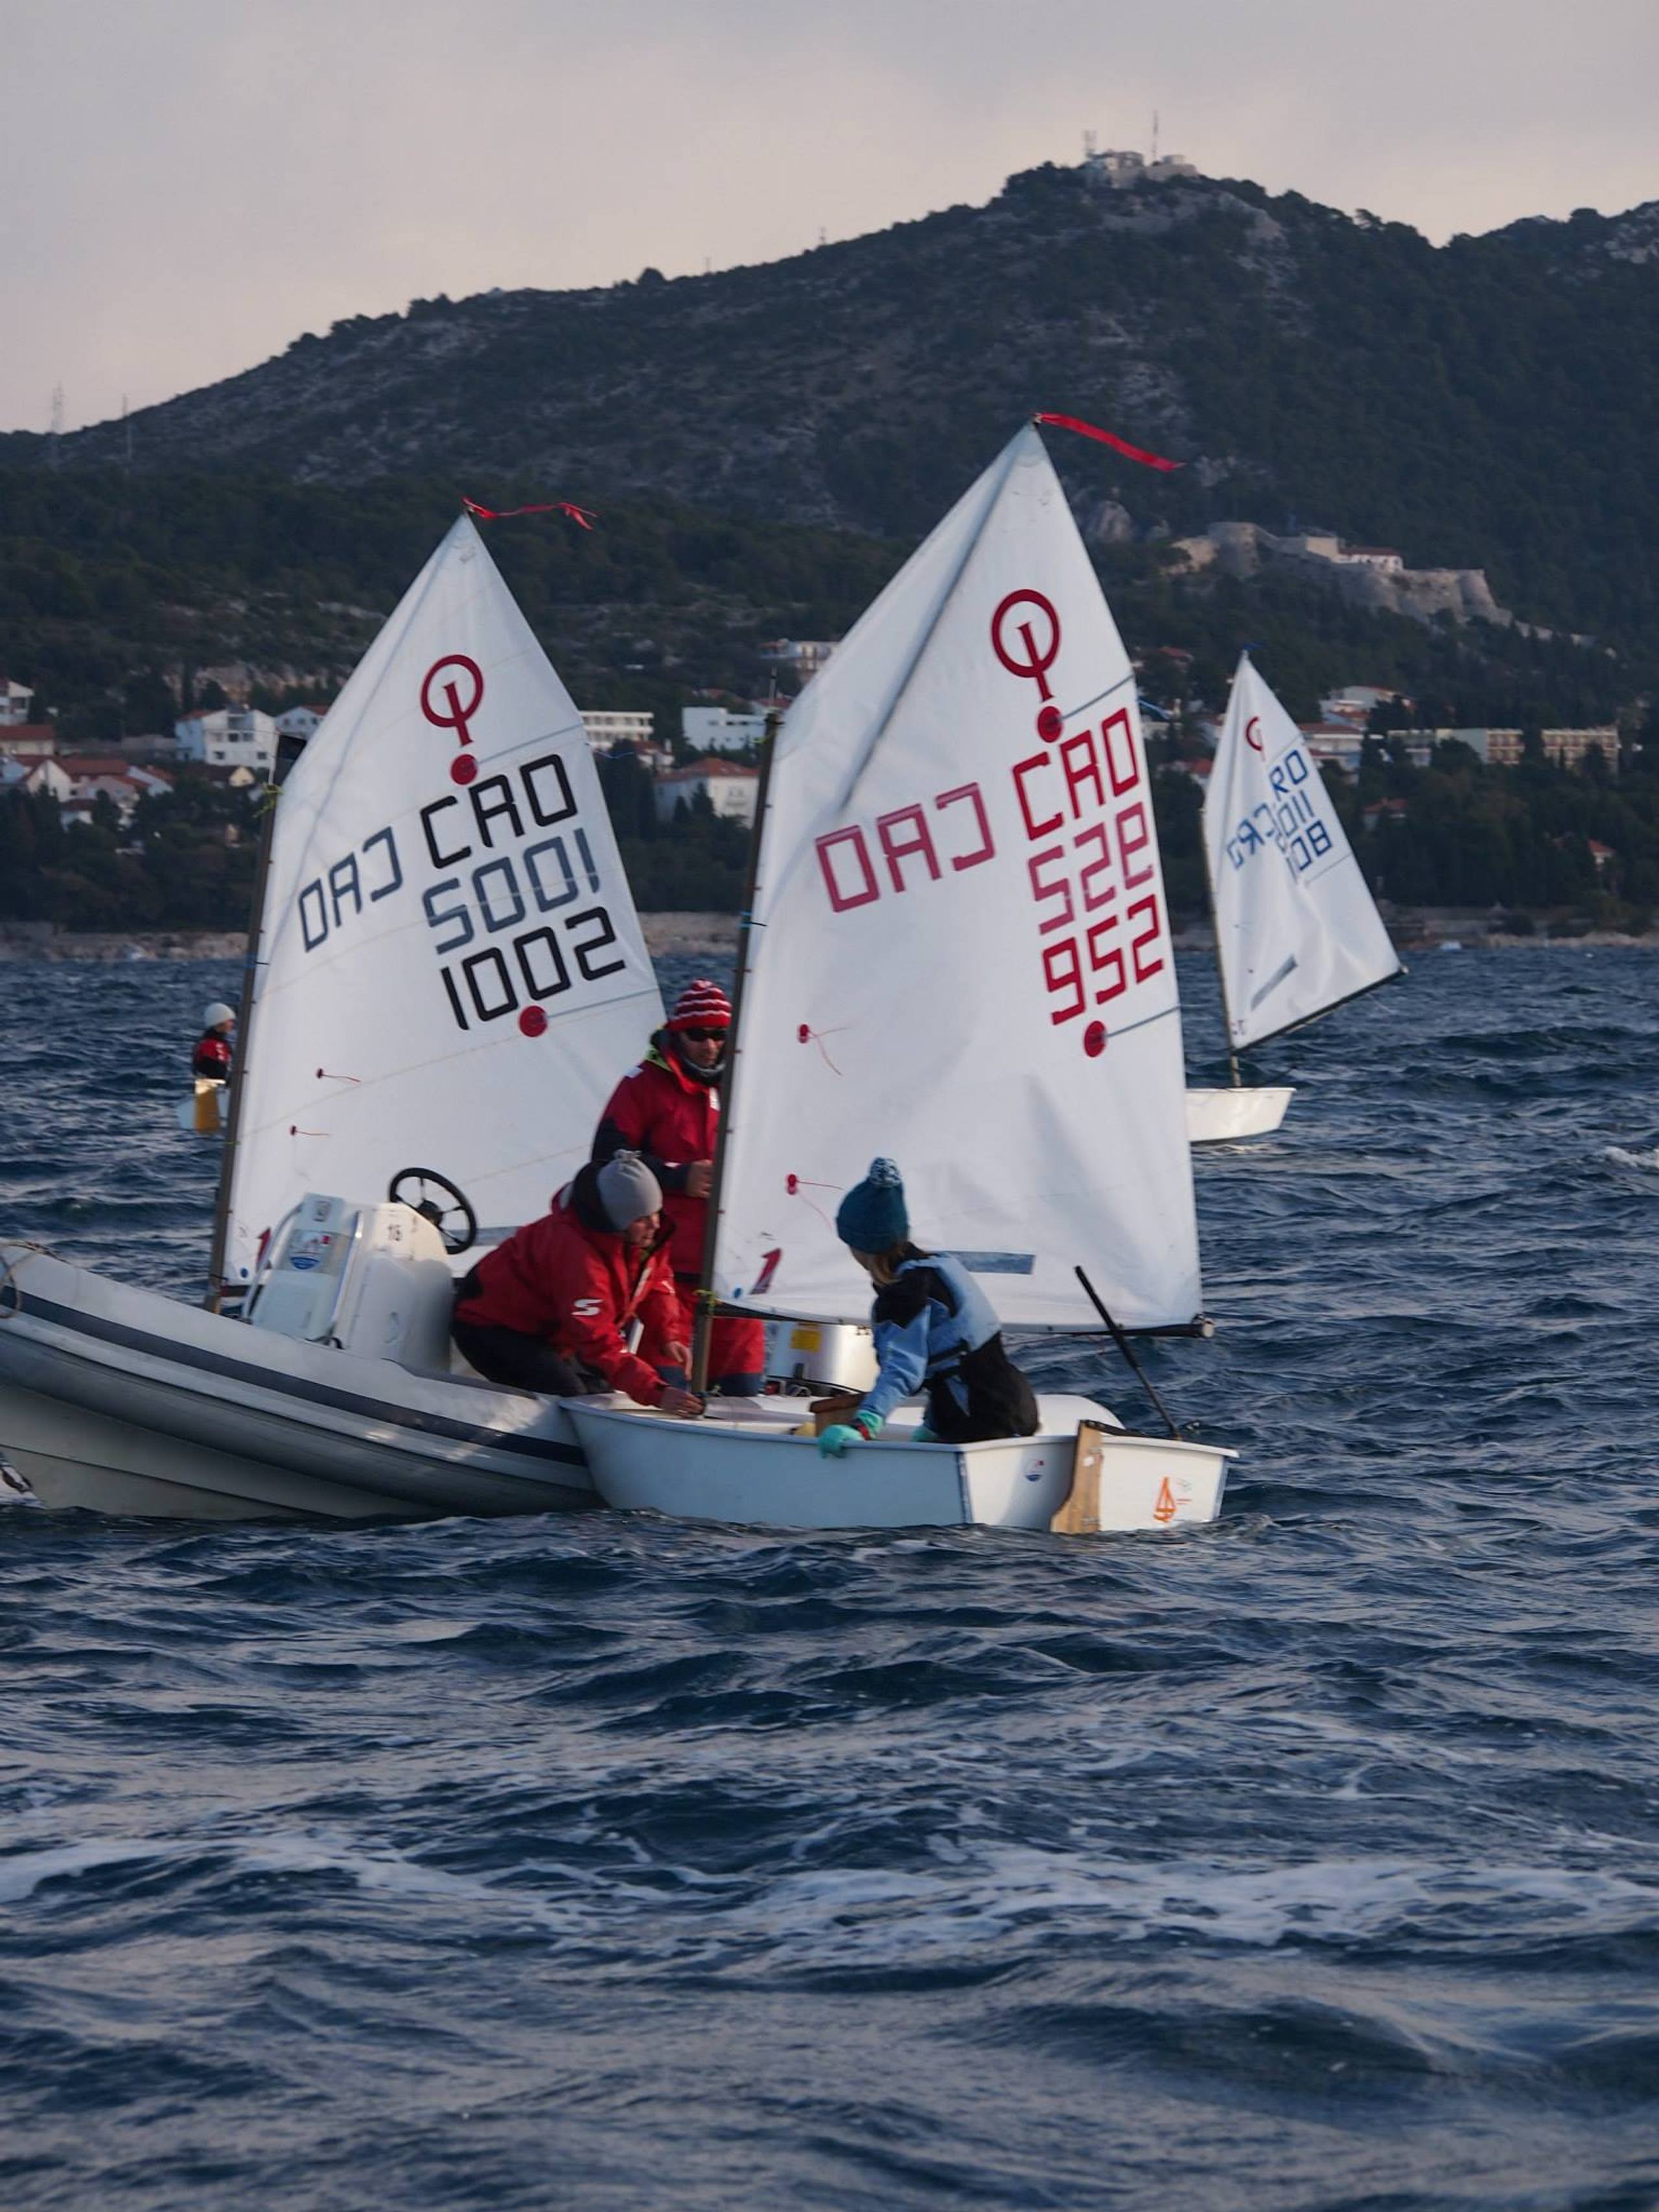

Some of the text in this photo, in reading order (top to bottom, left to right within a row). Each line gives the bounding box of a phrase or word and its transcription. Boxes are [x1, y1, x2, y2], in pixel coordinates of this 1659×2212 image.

[1268, 750, 1308, 802] RO
[441, 907, 625, 1030] 1002
[1042, 894, 1165, 1025] 952
